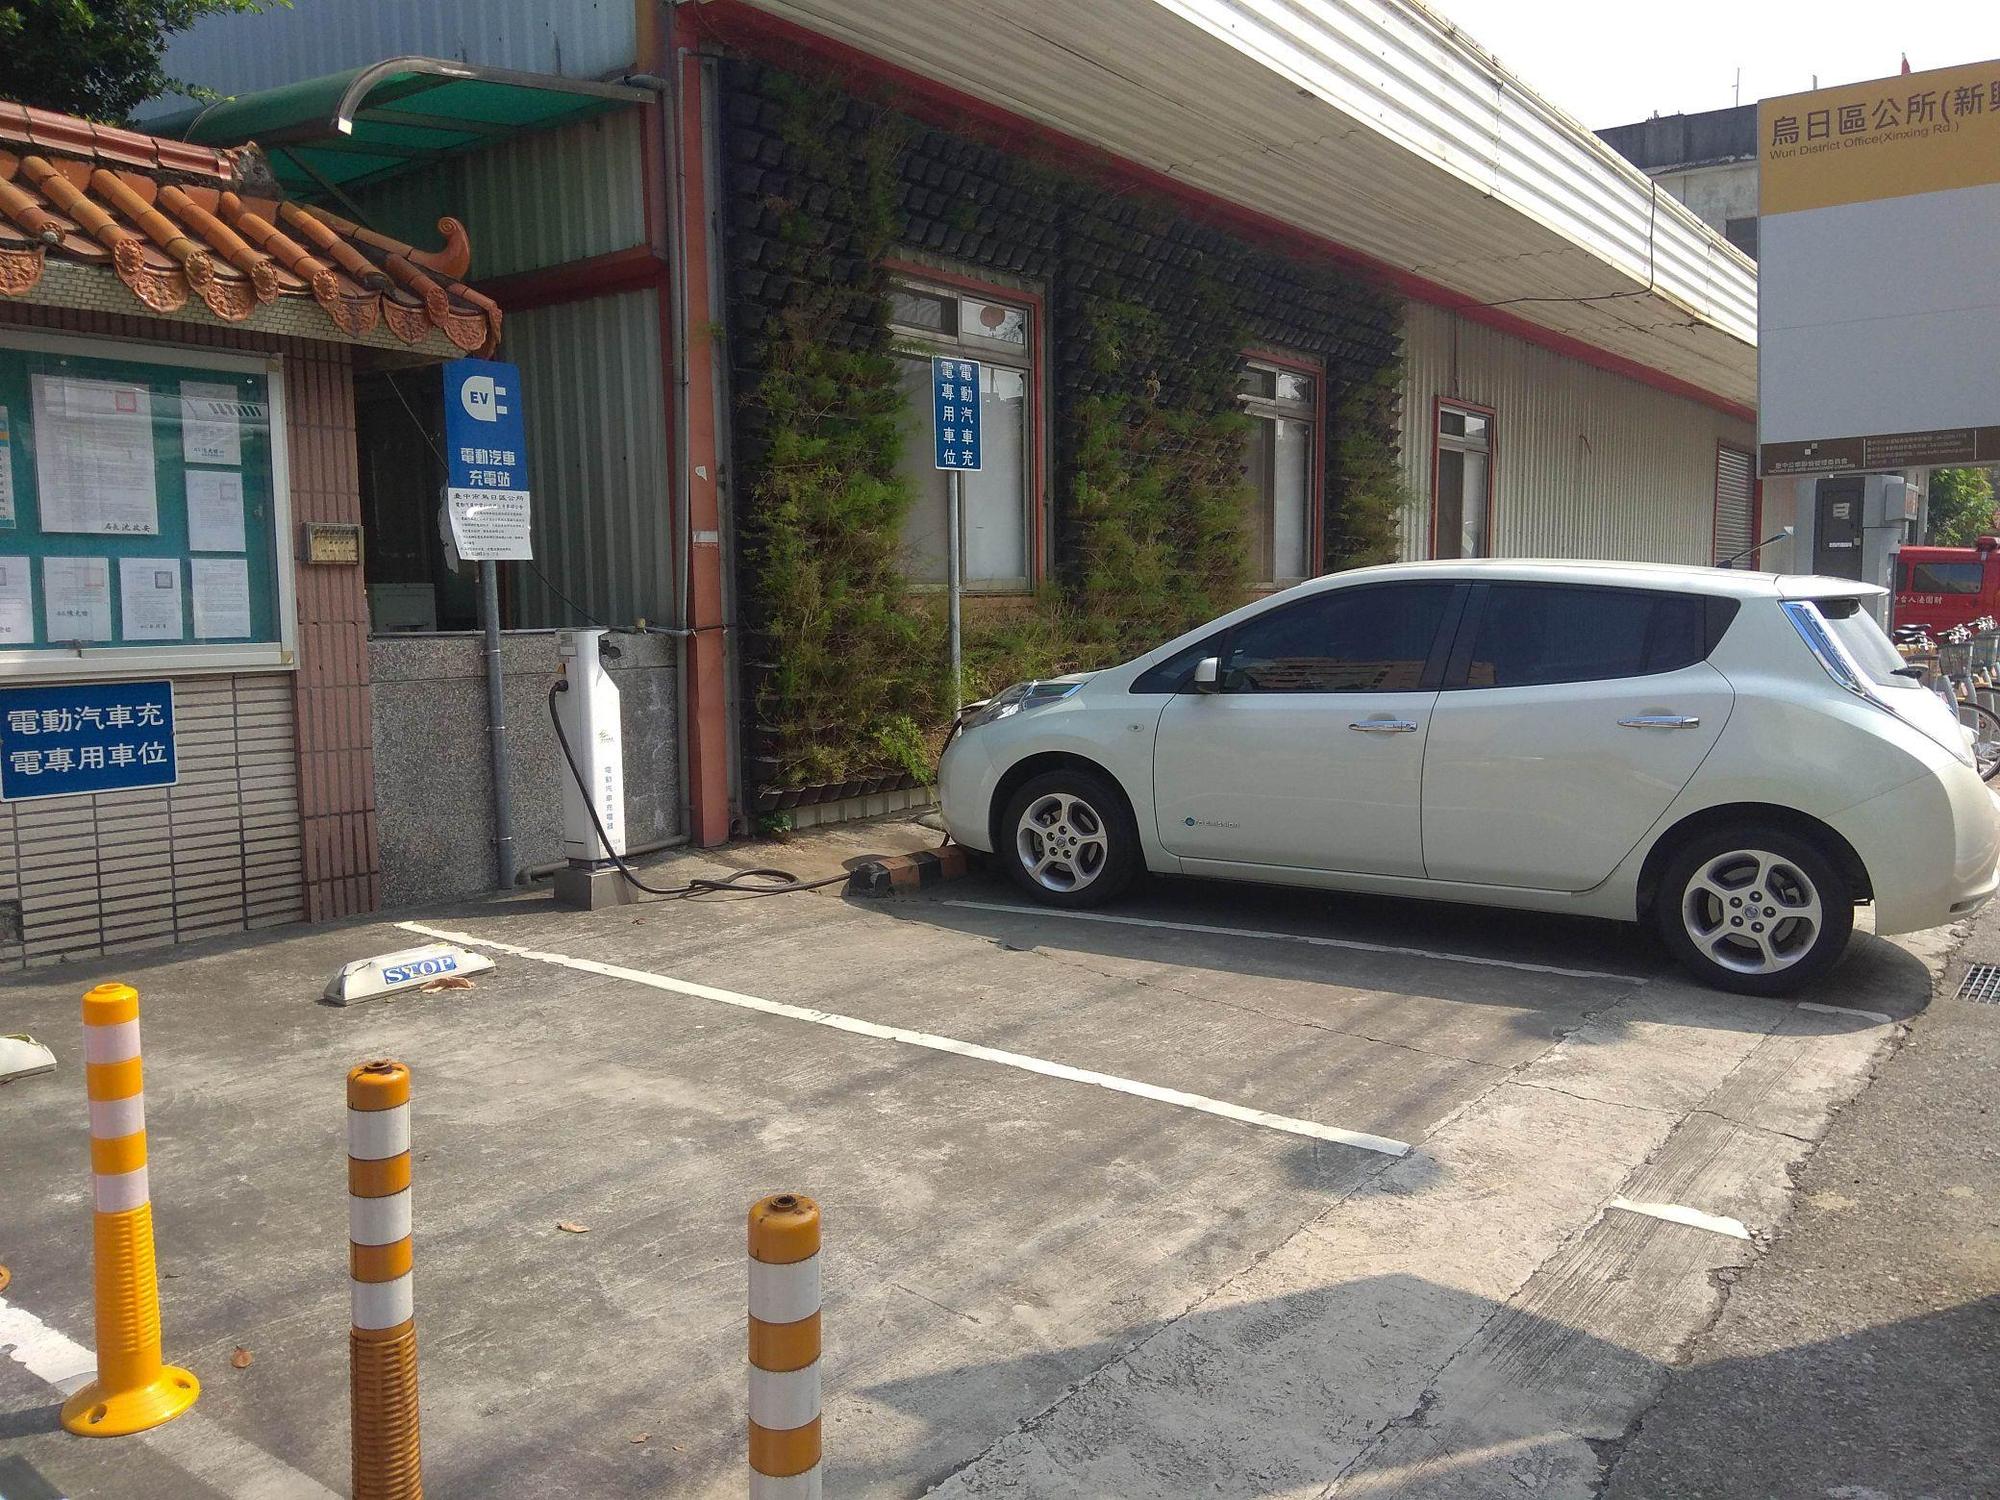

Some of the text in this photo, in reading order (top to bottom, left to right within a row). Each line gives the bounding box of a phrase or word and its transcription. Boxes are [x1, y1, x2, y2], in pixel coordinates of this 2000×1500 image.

[1769, 148, 1796, 160] Wuri
[1800, 141, 1841, 155] District
[470, 391, 489, 405] EV
[940, 361, 956, 465] 電專用車位
[960, 363, 974, 466] 電動汽車充
[460, 448, 516, 466] 電動汽車
[469, 470, 512, 488] 充電站
[7, 702, 164, 735] 電動汽車充
[9, 741, 168, 775] 電專用車位
[385, 956, 457, 984] STOP
